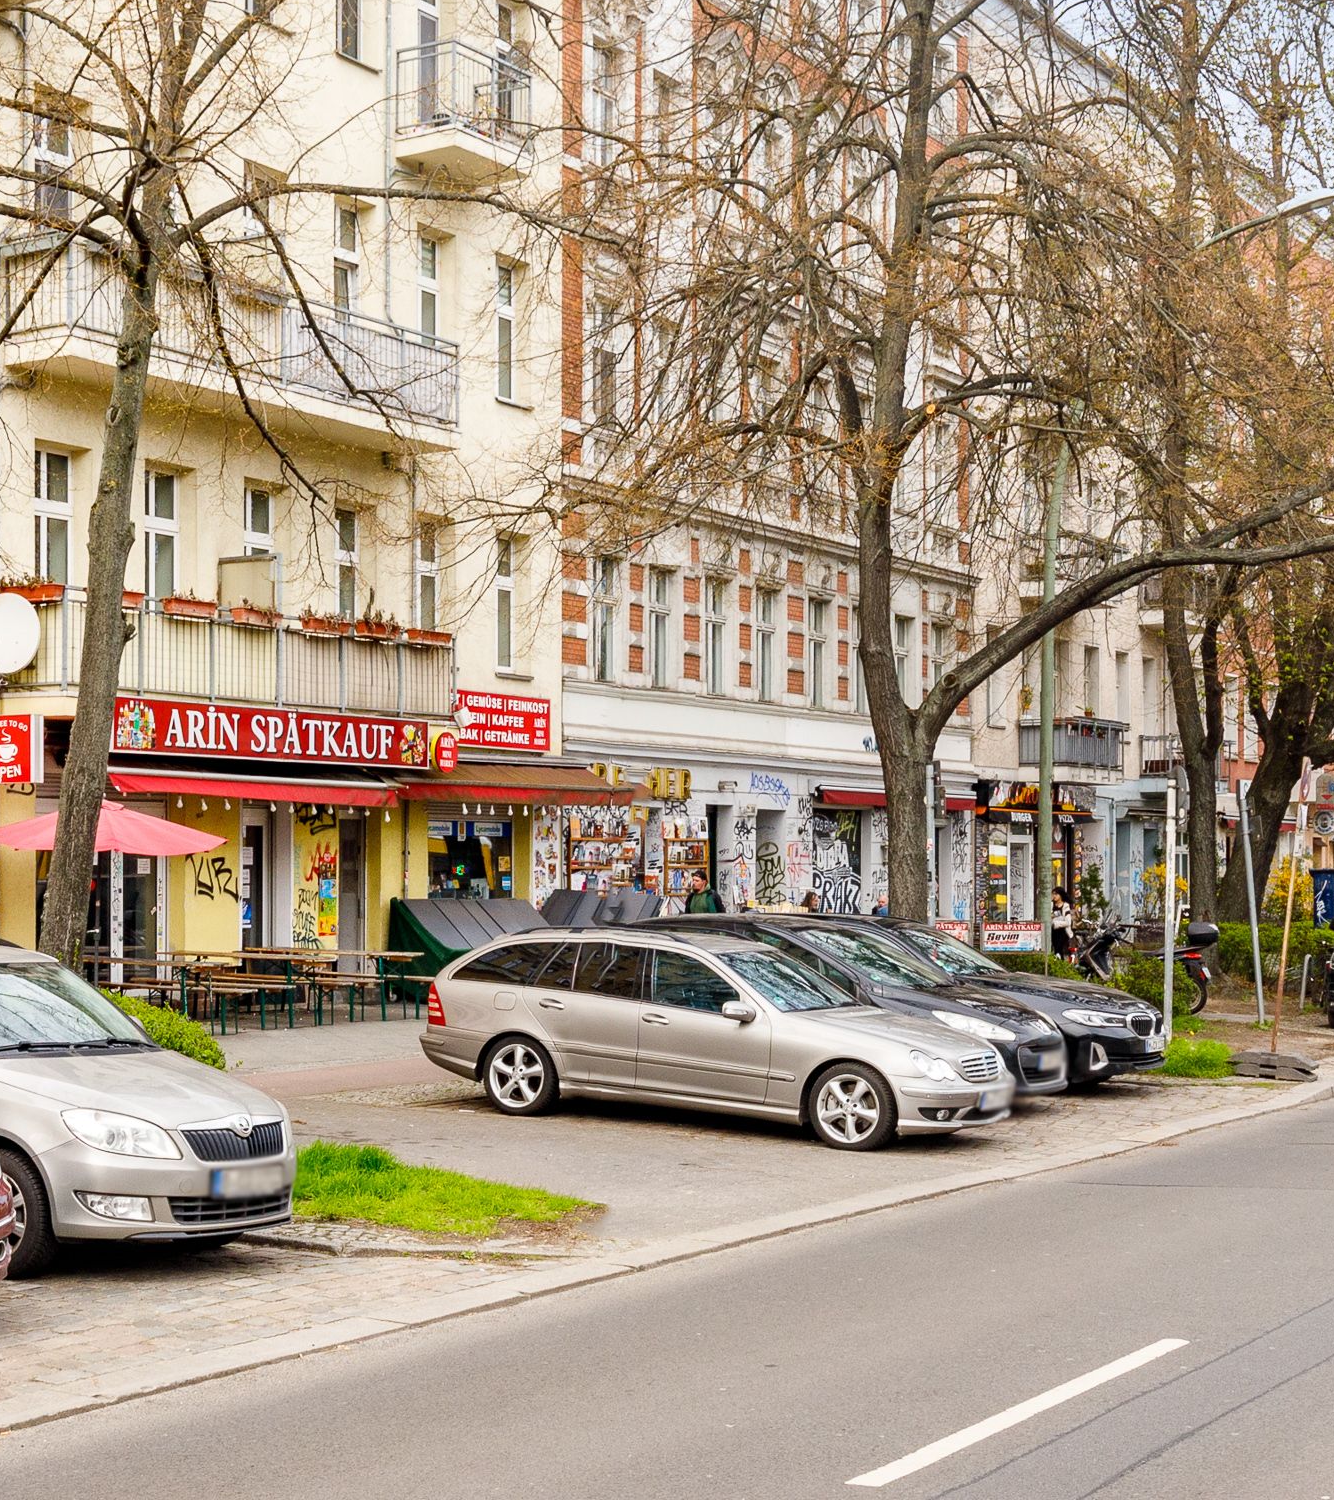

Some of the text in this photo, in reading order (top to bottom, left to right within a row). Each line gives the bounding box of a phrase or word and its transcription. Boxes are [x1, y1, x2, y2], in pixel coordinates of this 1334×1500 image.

[466, 694, 503, 710] GEMÜSE
[508, 699, 549, 714] FEINKOST
[8, 719, 18, 728] TO
[18, 722, 29, 732] GO
[492, 713, 525, 728] KAFFEE
[250, 711, 394, 760] SPÄTKAUF
[484, 729, 530, 745] GETRÄNKE
[1003, 922, 1041, 931] SPÄTKAUF
